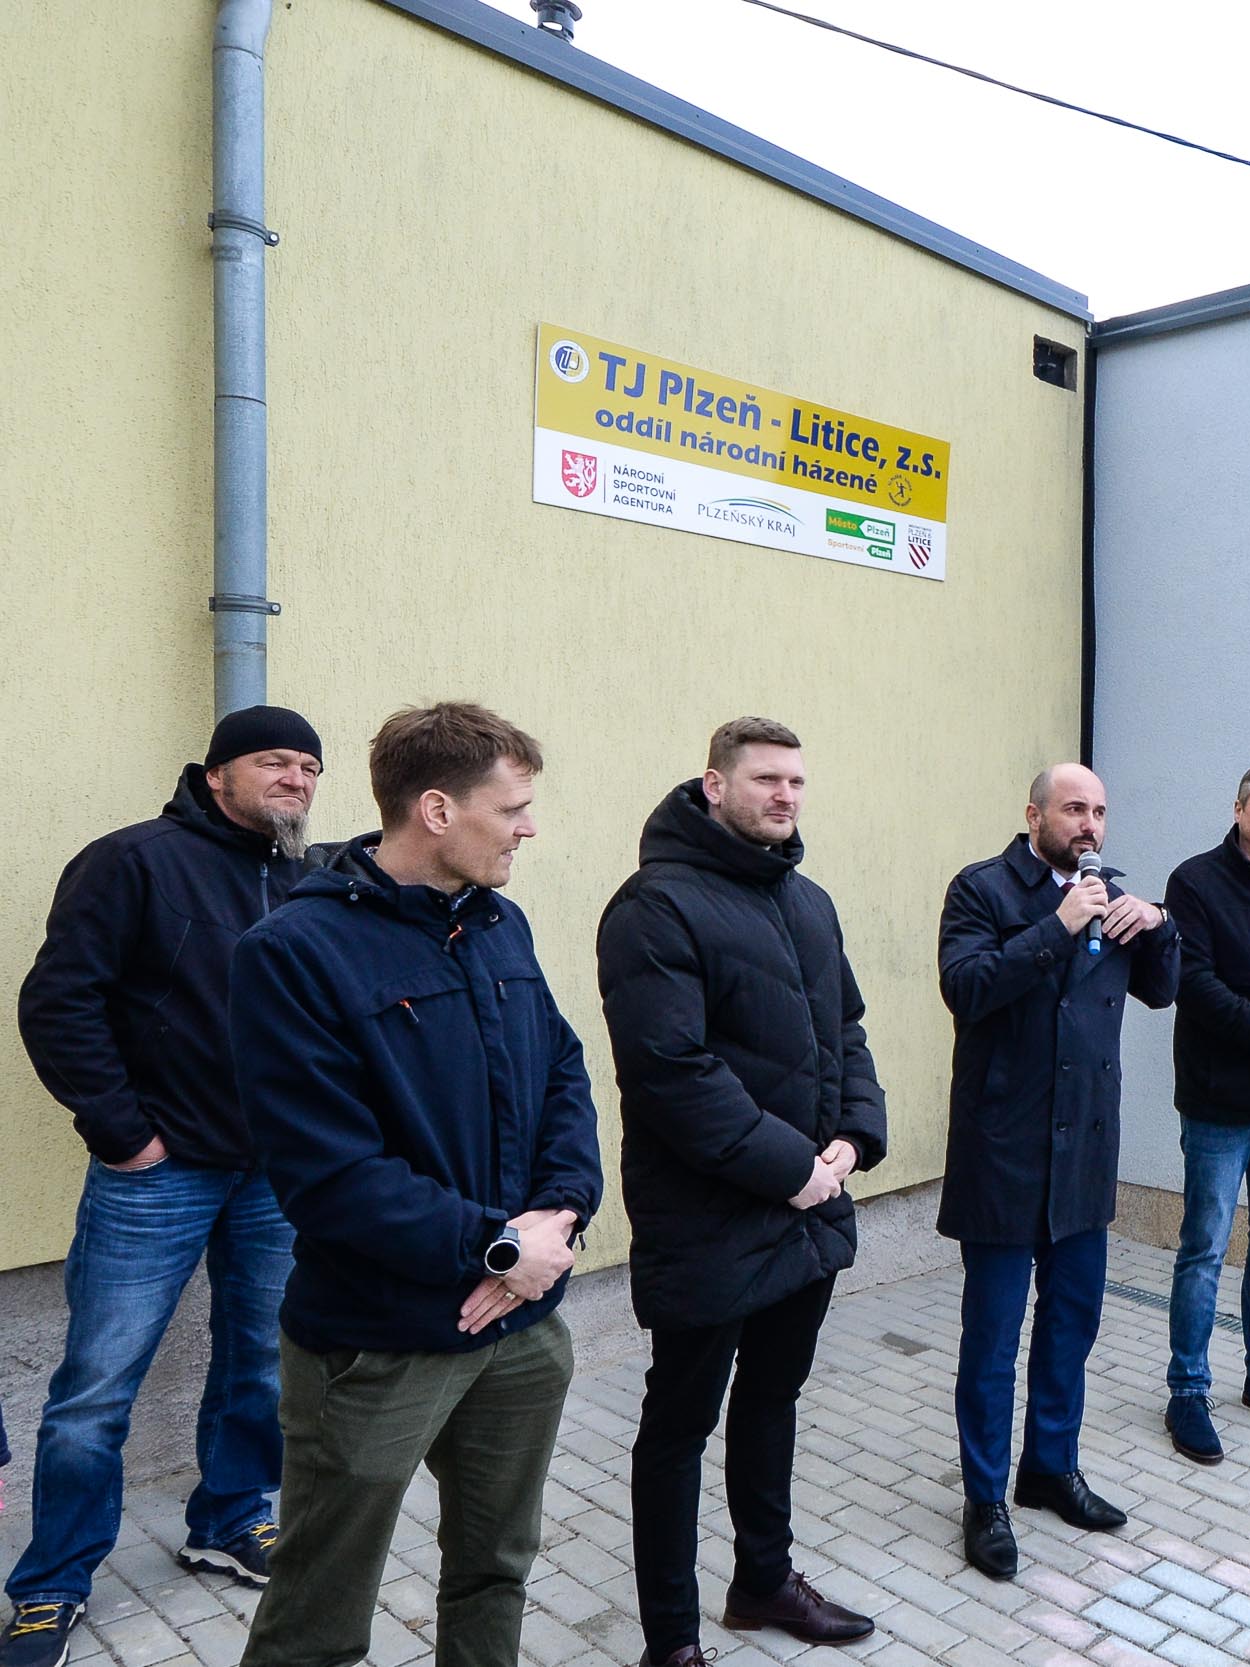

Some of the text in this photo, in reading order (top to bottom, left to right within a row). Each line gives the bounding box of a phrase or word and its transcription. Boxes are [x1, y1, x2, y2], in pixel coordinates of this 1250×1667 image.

[599, 351, 646, 398] TJ
[658, 369, 762, 431] Plzeň
[790, 408, 888, 470] Litice,
[896, 446, 941, 479] z.s.
[595, 408, 878, 494] oddíl národní házené
[613, 464, 664, 485] NÁRODNÍ
[613, 479, 676, 502] SPORTOVNÍ
[613, 494, 673, 515] AGENTURA
[698, 503, 796, 537] PLZEŇSKÝ KRAJ
[866, 524, 890, 537] Plzeň
[908, 536, 932, 547] LITICE
